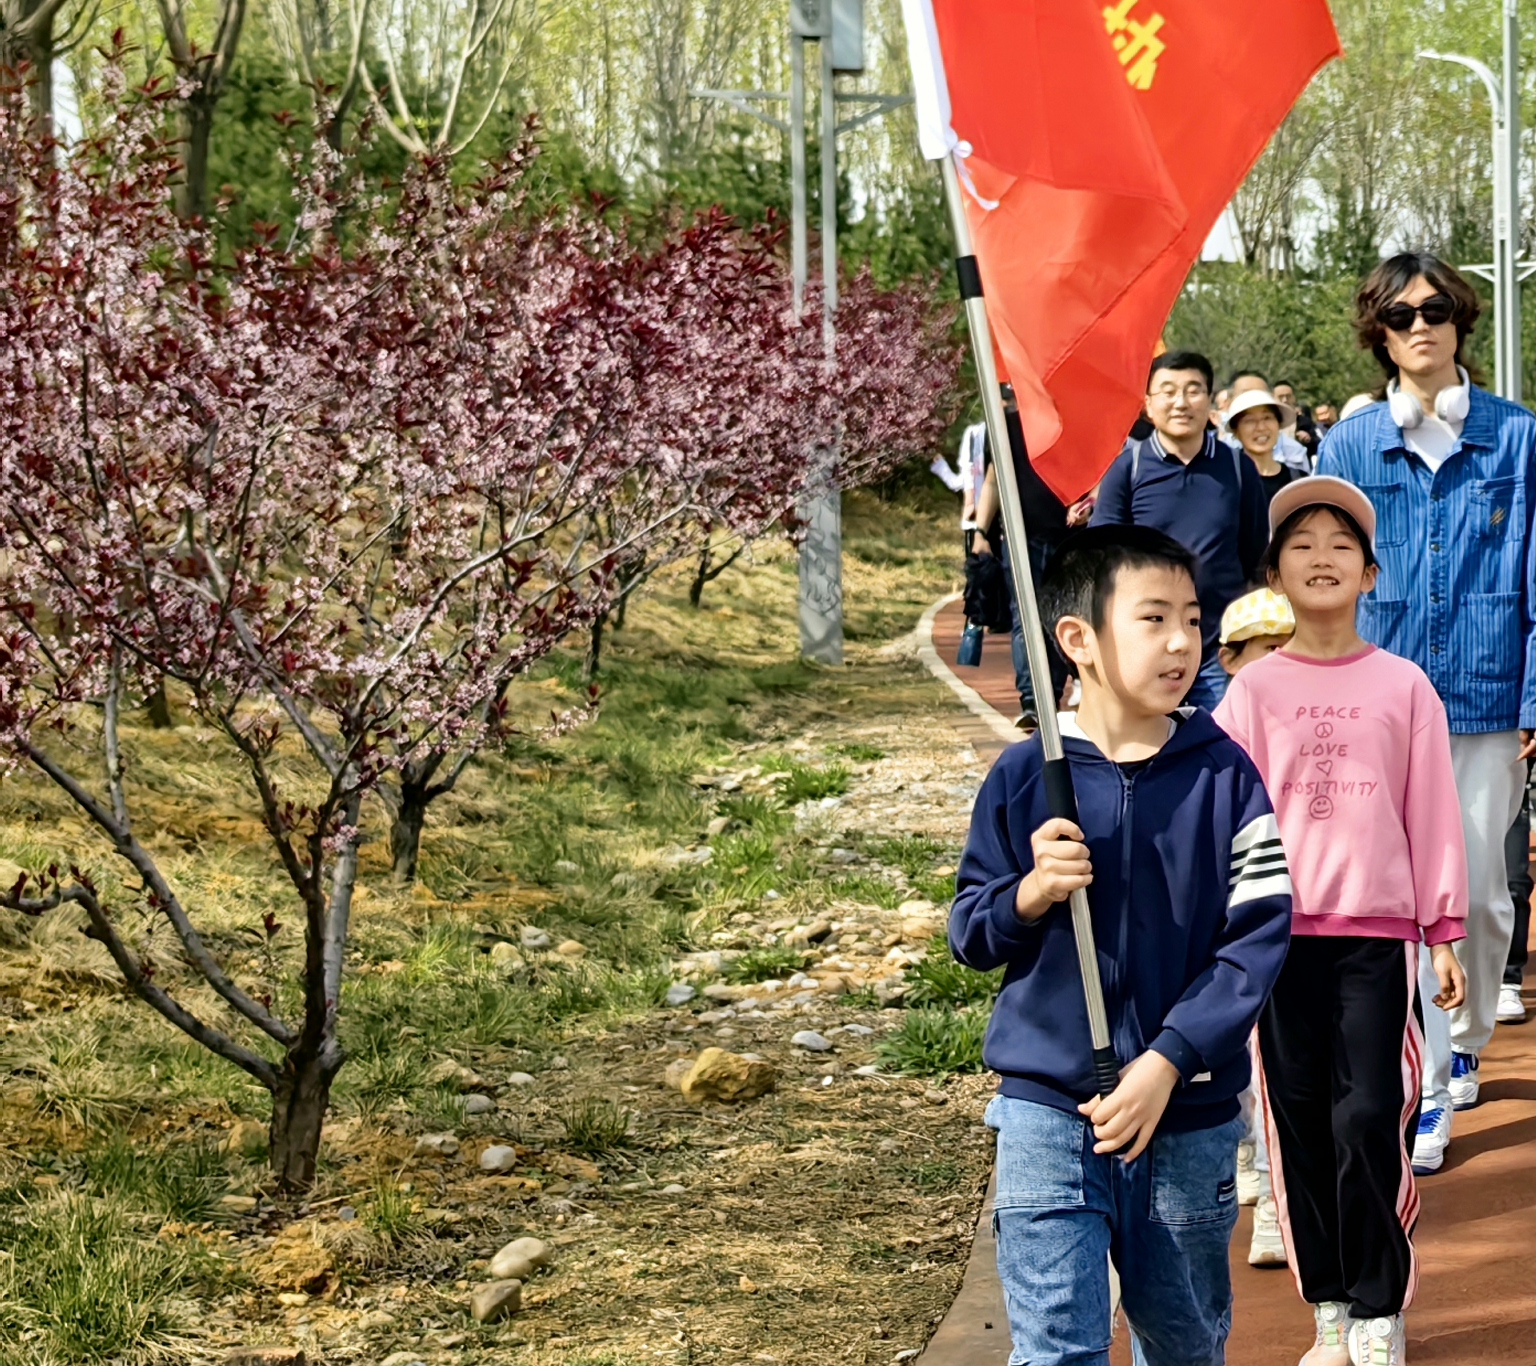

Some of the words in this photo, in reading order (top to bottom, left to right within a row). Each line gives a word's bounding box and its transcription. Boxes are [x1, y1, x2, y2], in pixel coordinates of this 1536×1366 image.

[1296, 705, 1361, 720] PEACE
[1299, 743, 1348, 757] LOVE
[1281, 780, 1378, 797] POSITIVITY
